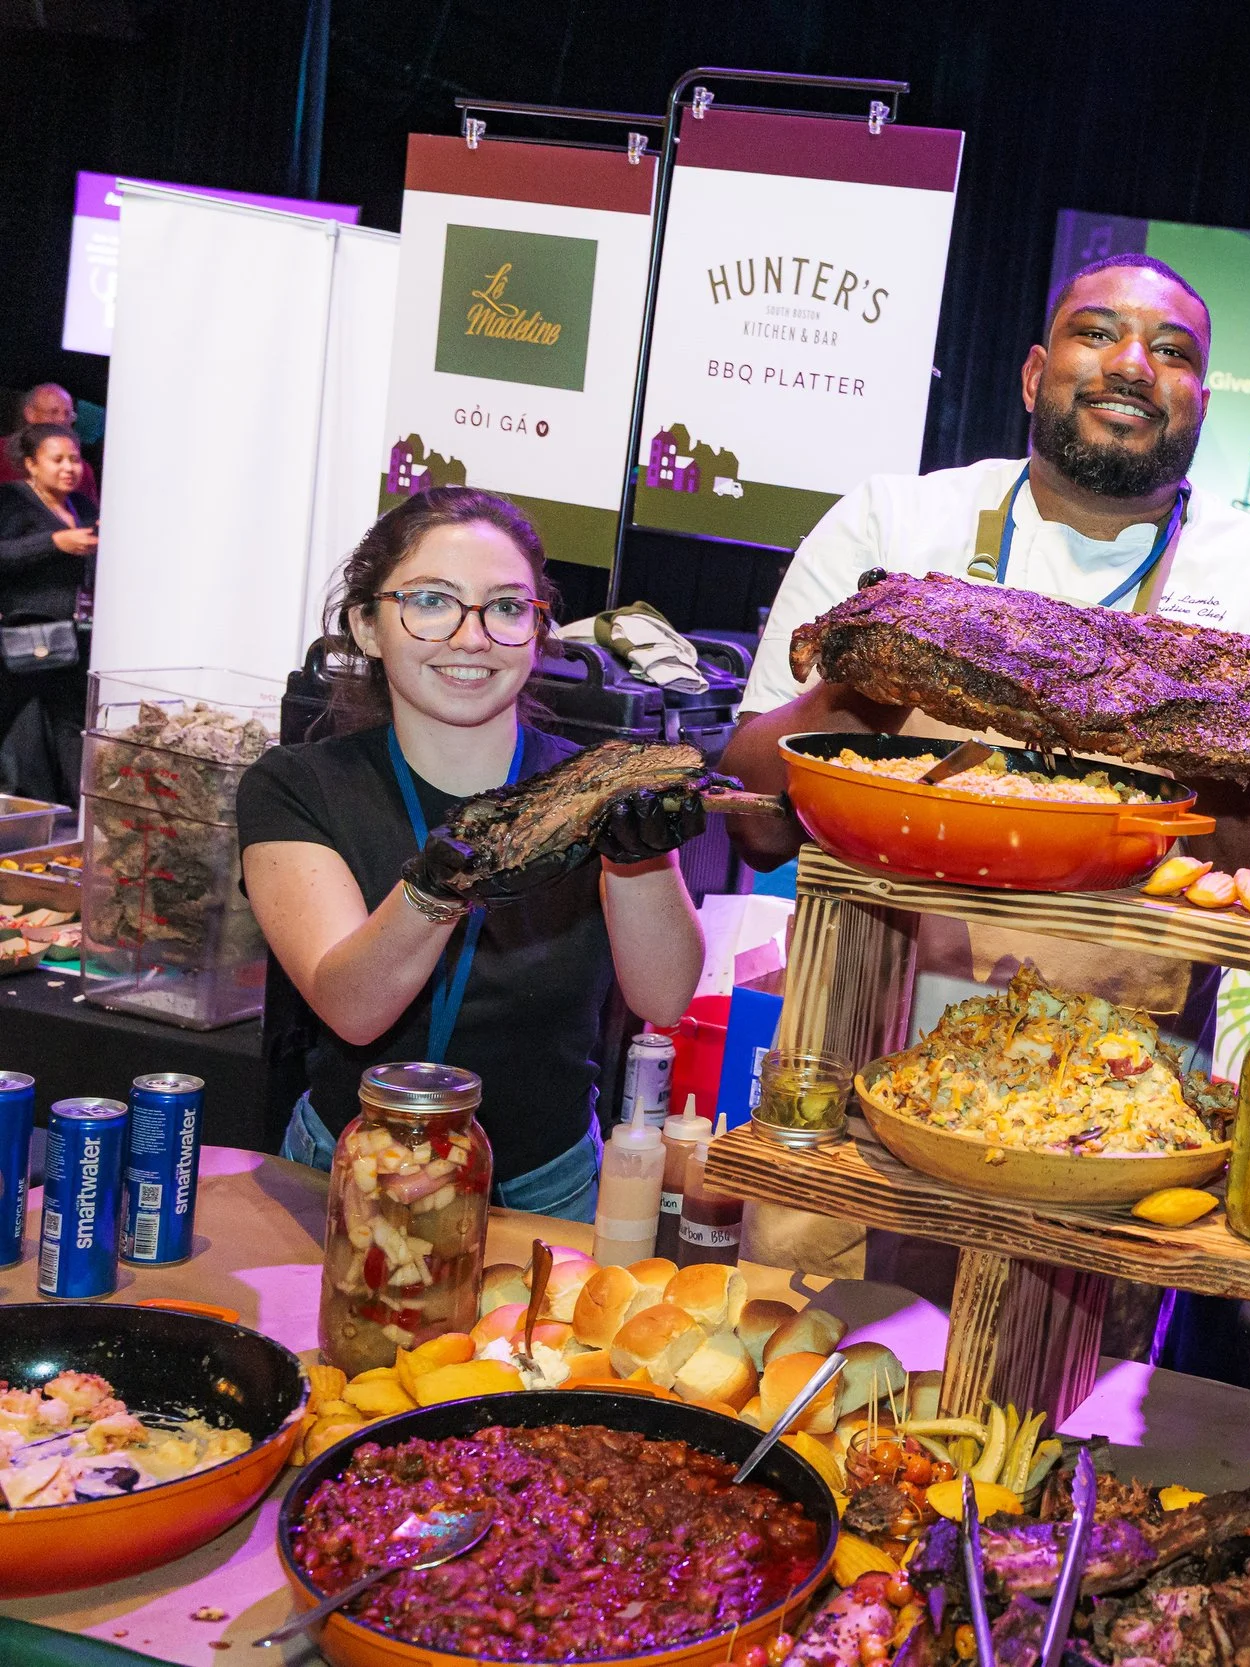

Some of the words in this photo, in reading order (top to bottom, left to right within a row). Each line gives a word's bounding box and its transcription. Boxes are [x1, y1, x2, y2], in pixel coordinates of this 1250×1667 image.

[707, 255, 890, 324] HUNTER'S
[464, 303, 562, 346] Madeline
[765, 305, 791, 318] SOUTH
[792, 308, 821, 321] BOSTON
[743, 320, 796, 342] KITCHEN
[800, 327, 808, 343] &
[813, 329, 839, 347] BAR
[707, 359, 753, 385] BBQ
[763, 367, 865, 397] PLATTER
[1160, 591, 1174, 604] ef
[1197, 608, 1227, 621] Chef
[660, 1197, 677, 1208] rbon
[14, 1196, 24, 1238] RECYCLE
